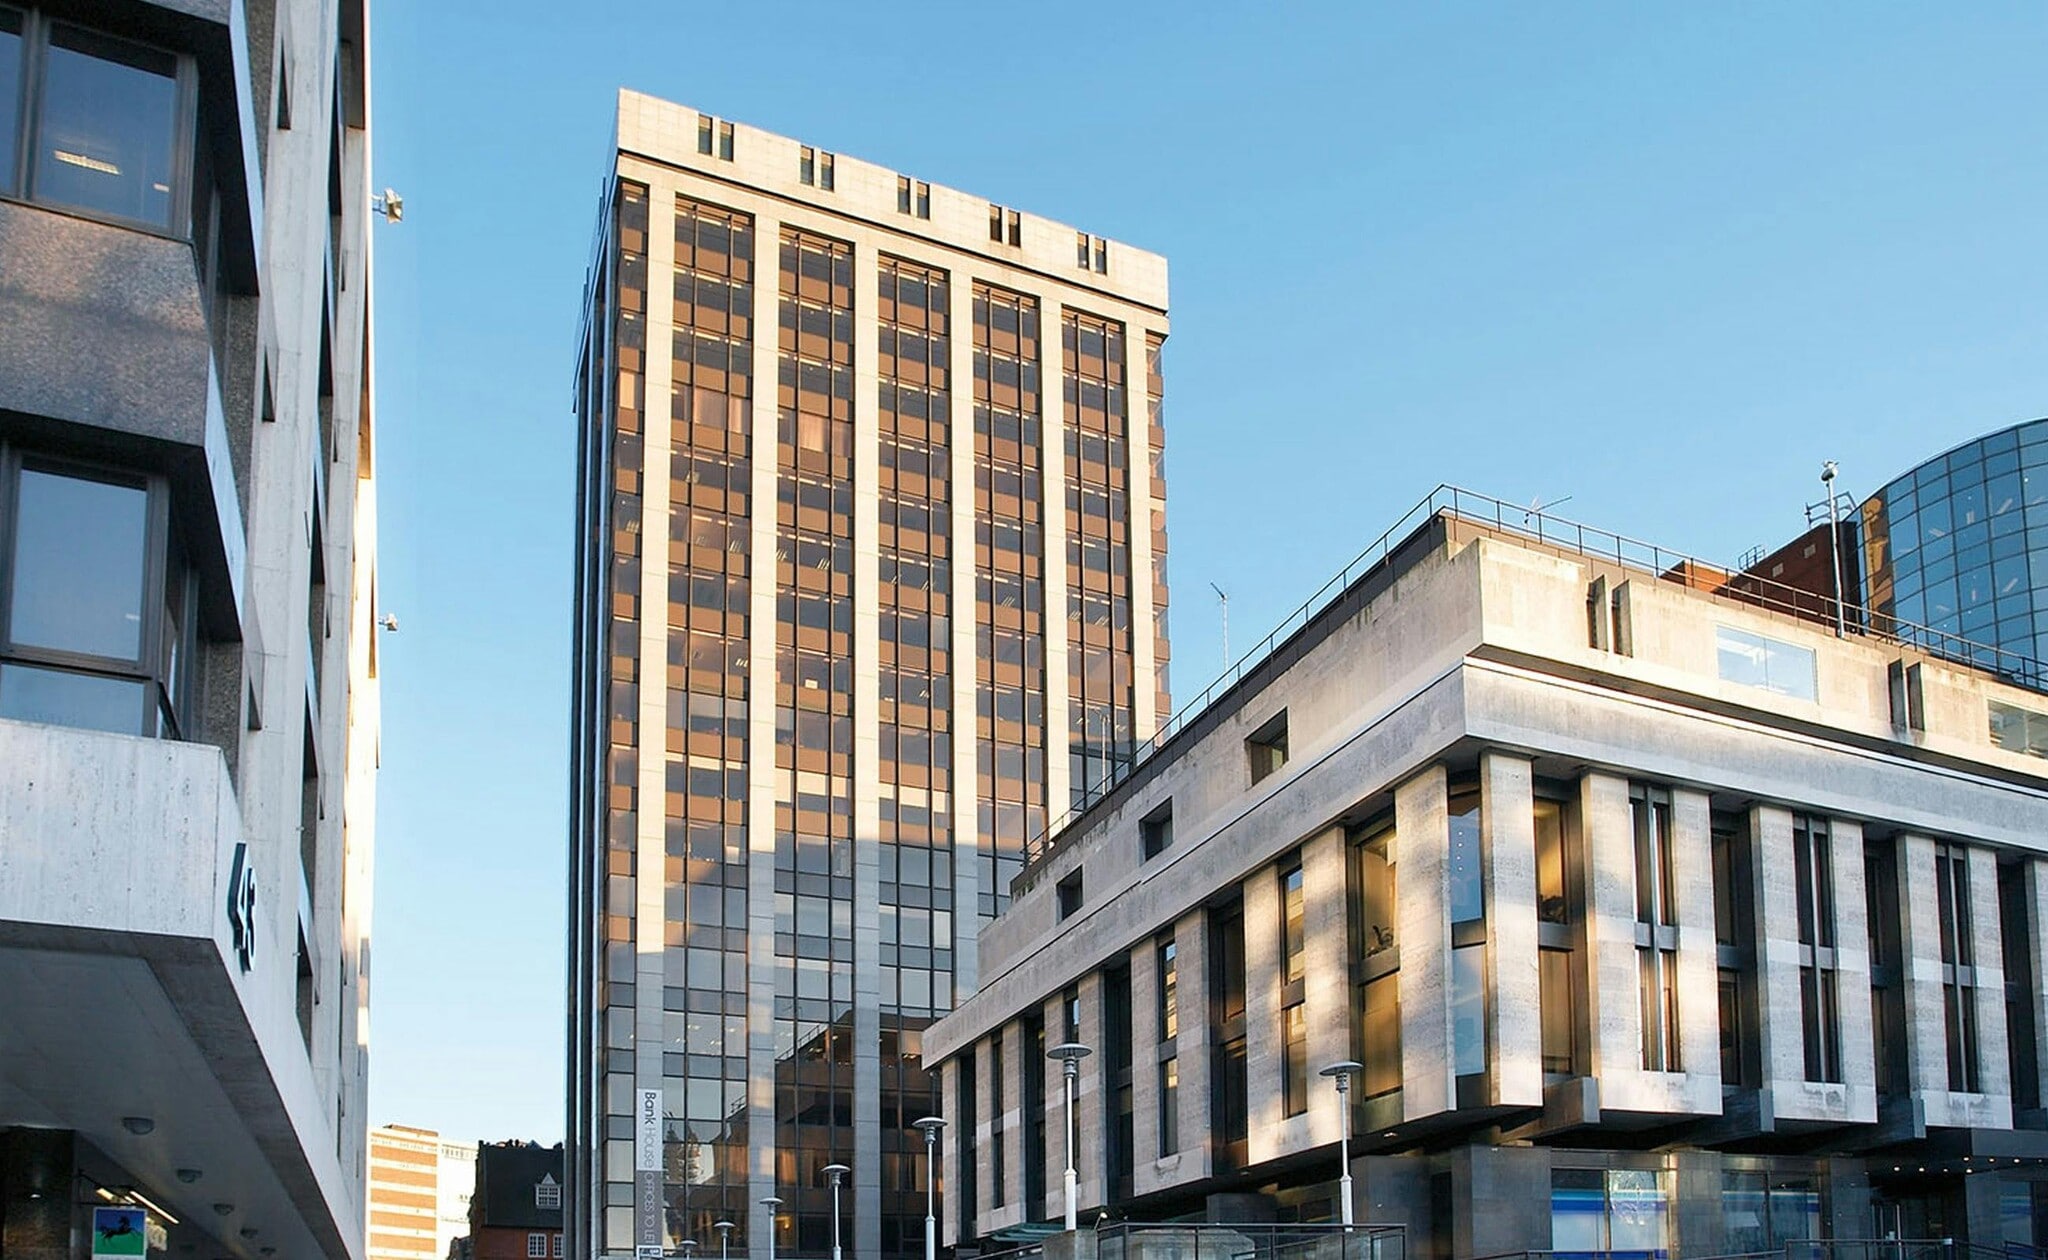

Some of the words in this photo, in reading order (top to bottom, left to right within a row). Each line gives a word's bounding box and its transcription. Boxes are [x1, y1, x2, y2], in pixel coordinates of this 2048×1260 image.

[644, 1092, 656, 1124] Bank
[644, 1127, 656, 1168] House
[644, 1172, 655, 1212] OFFICES
[644, 1214, 655, 1227] TO
[644, 1229, 655, 1243] LET
